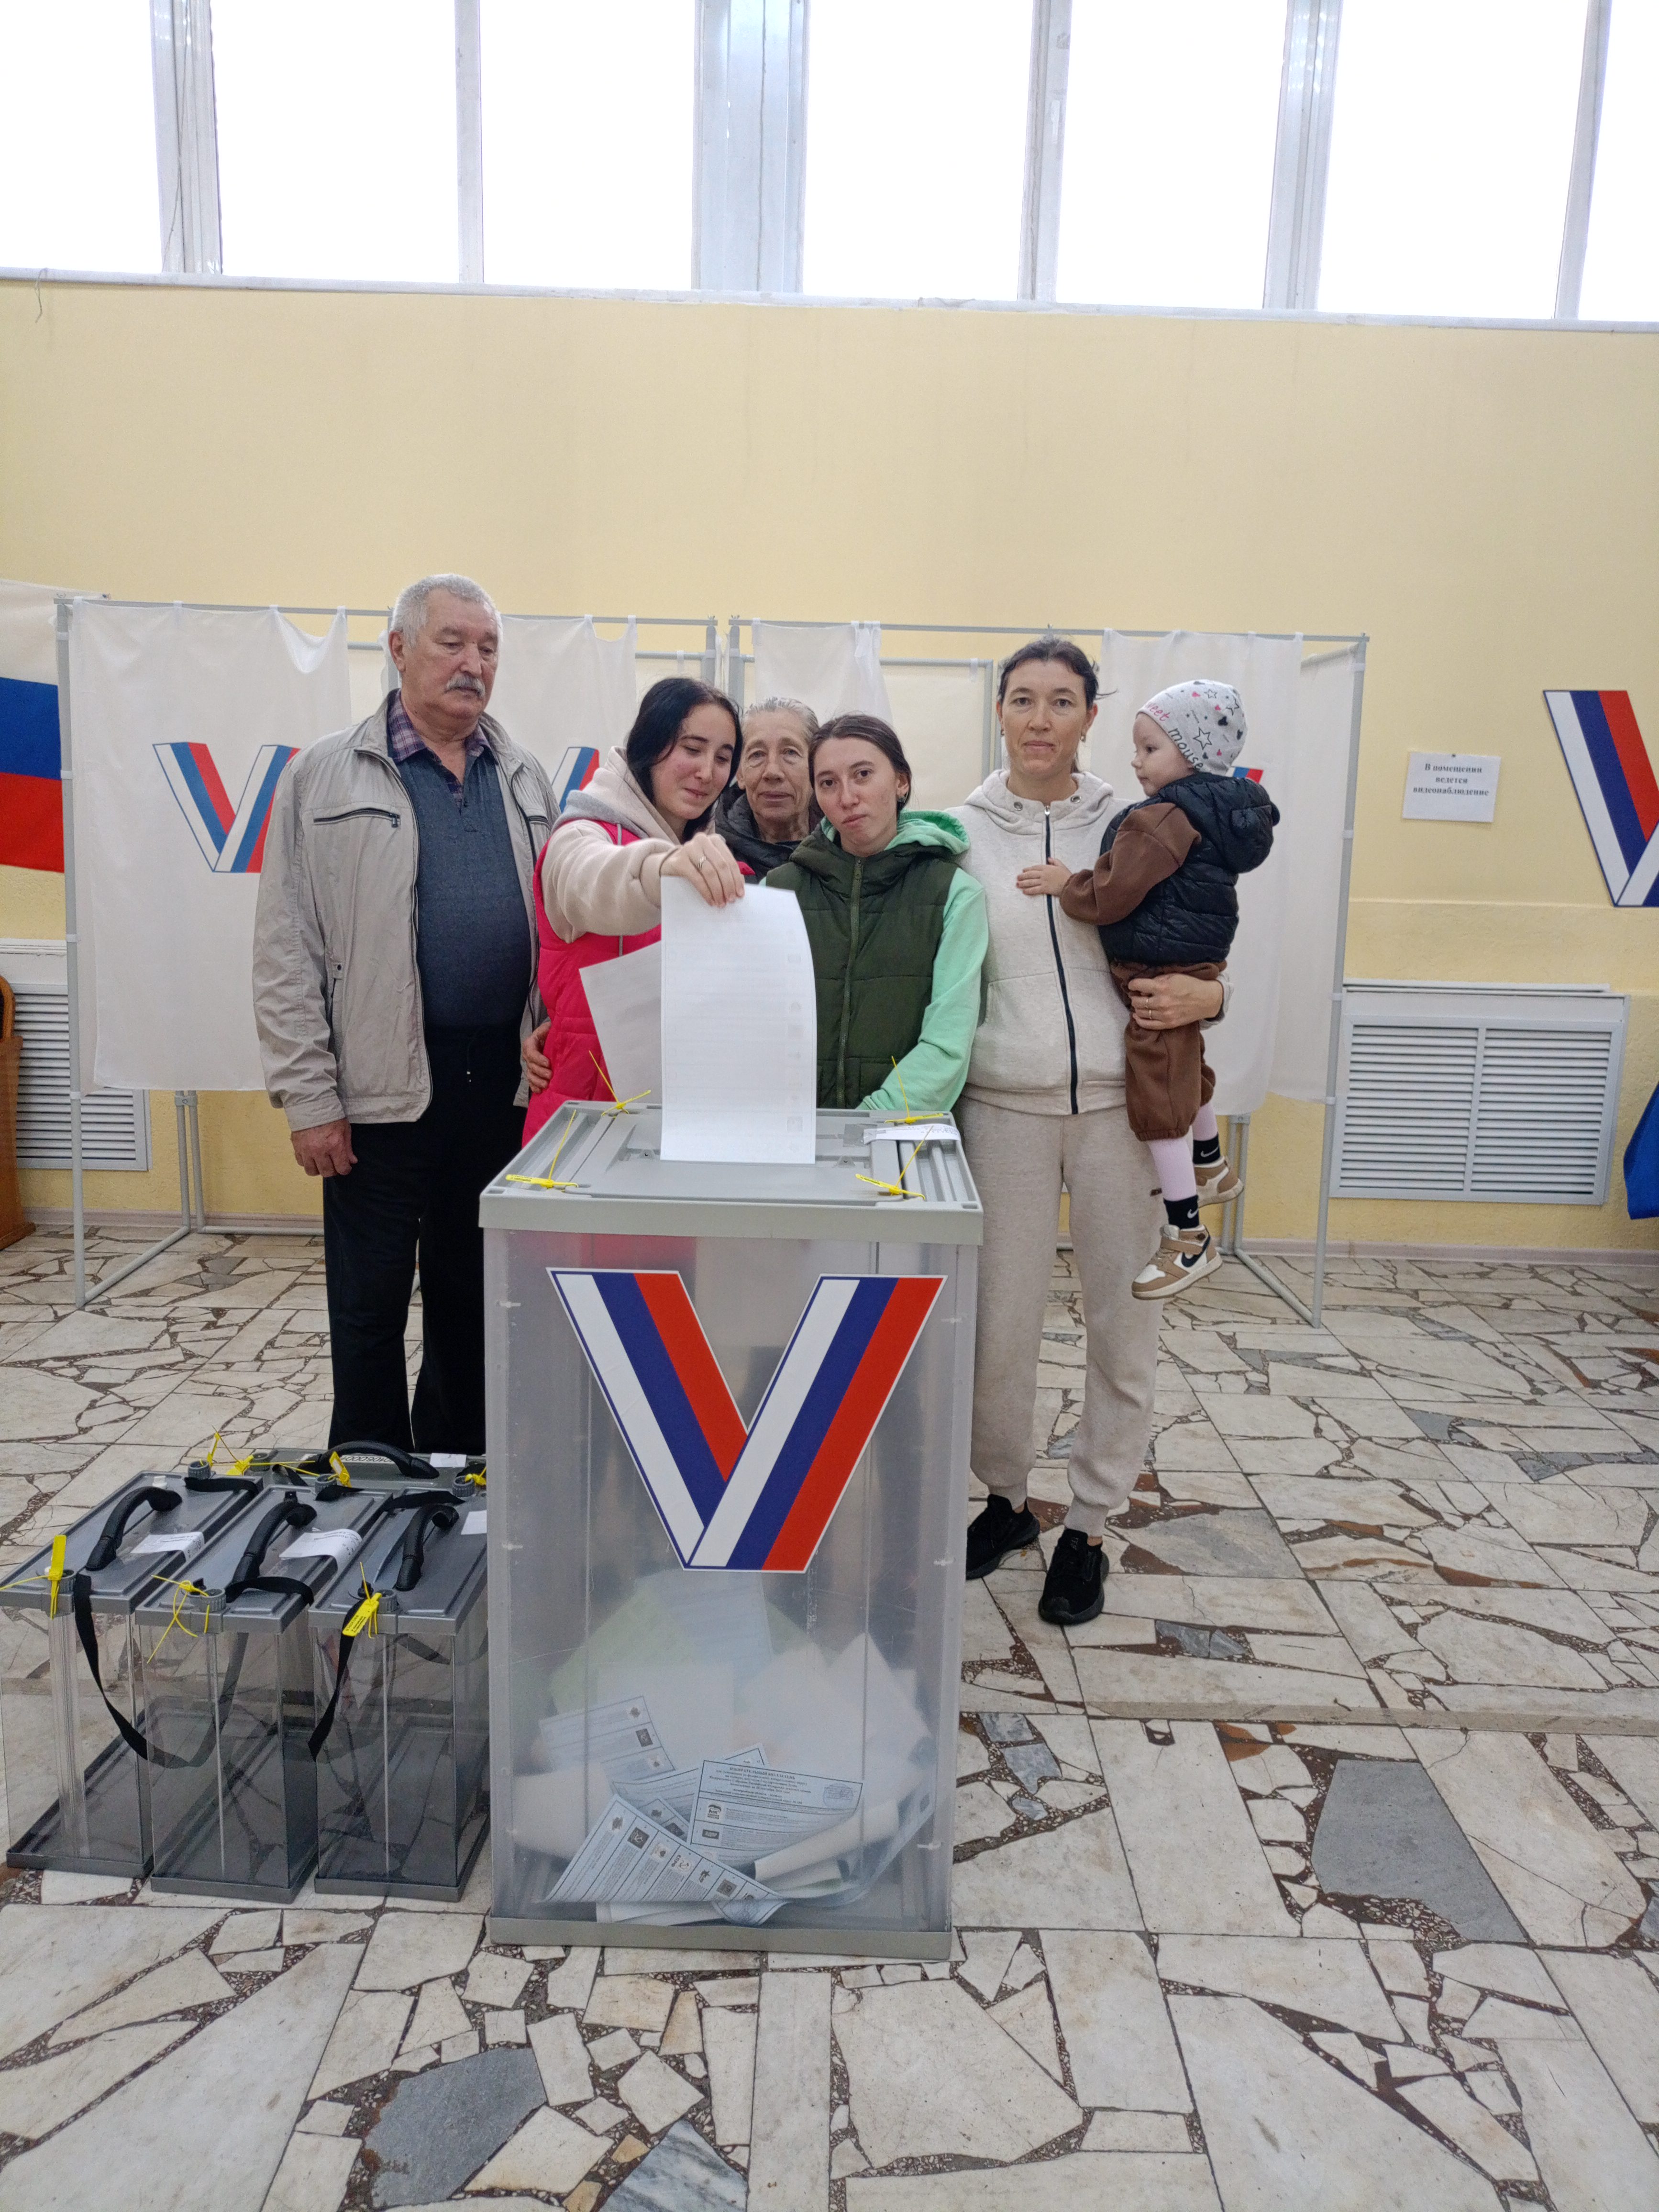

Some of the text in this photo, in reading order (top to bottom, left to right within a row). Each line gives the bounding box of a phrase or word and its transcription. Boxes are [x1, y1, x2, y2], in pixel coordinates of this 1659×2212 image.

[1168, 728, 1204, 770] mouse
[1433, 765, 1482, 774] помещении
[1413, 786, 1489, 796] видеонаблюдение
